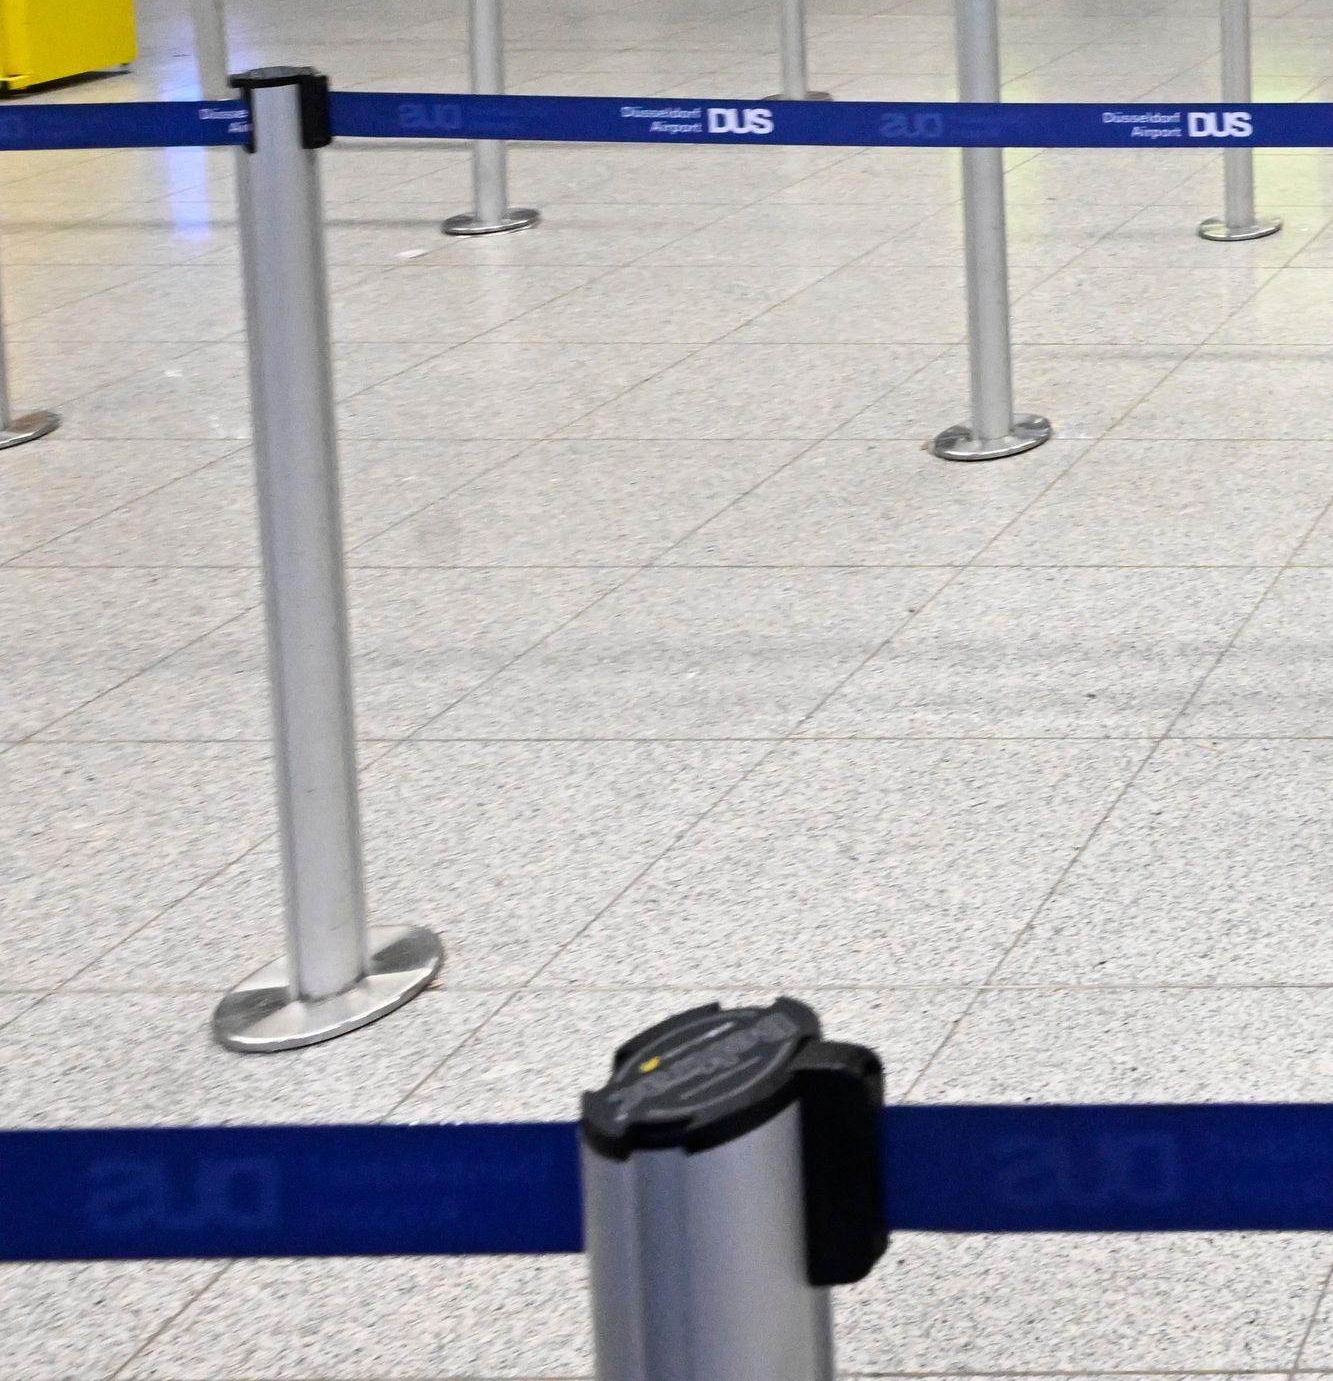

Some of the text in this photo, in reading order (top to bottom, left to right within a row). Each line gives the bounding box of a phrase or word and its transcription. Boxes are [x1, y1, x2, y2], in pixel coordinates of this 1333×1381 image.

[620, 106, 702, 119] Düsseldorf
[1101, 111, 1182, 124] Düsseldorf
[650, 121, 702, 135] Airport
[707, 109, 775, 134] DUS
[1188, 112, 1253, 138] DUS
[1131, 126, 1182, 142] Airport
